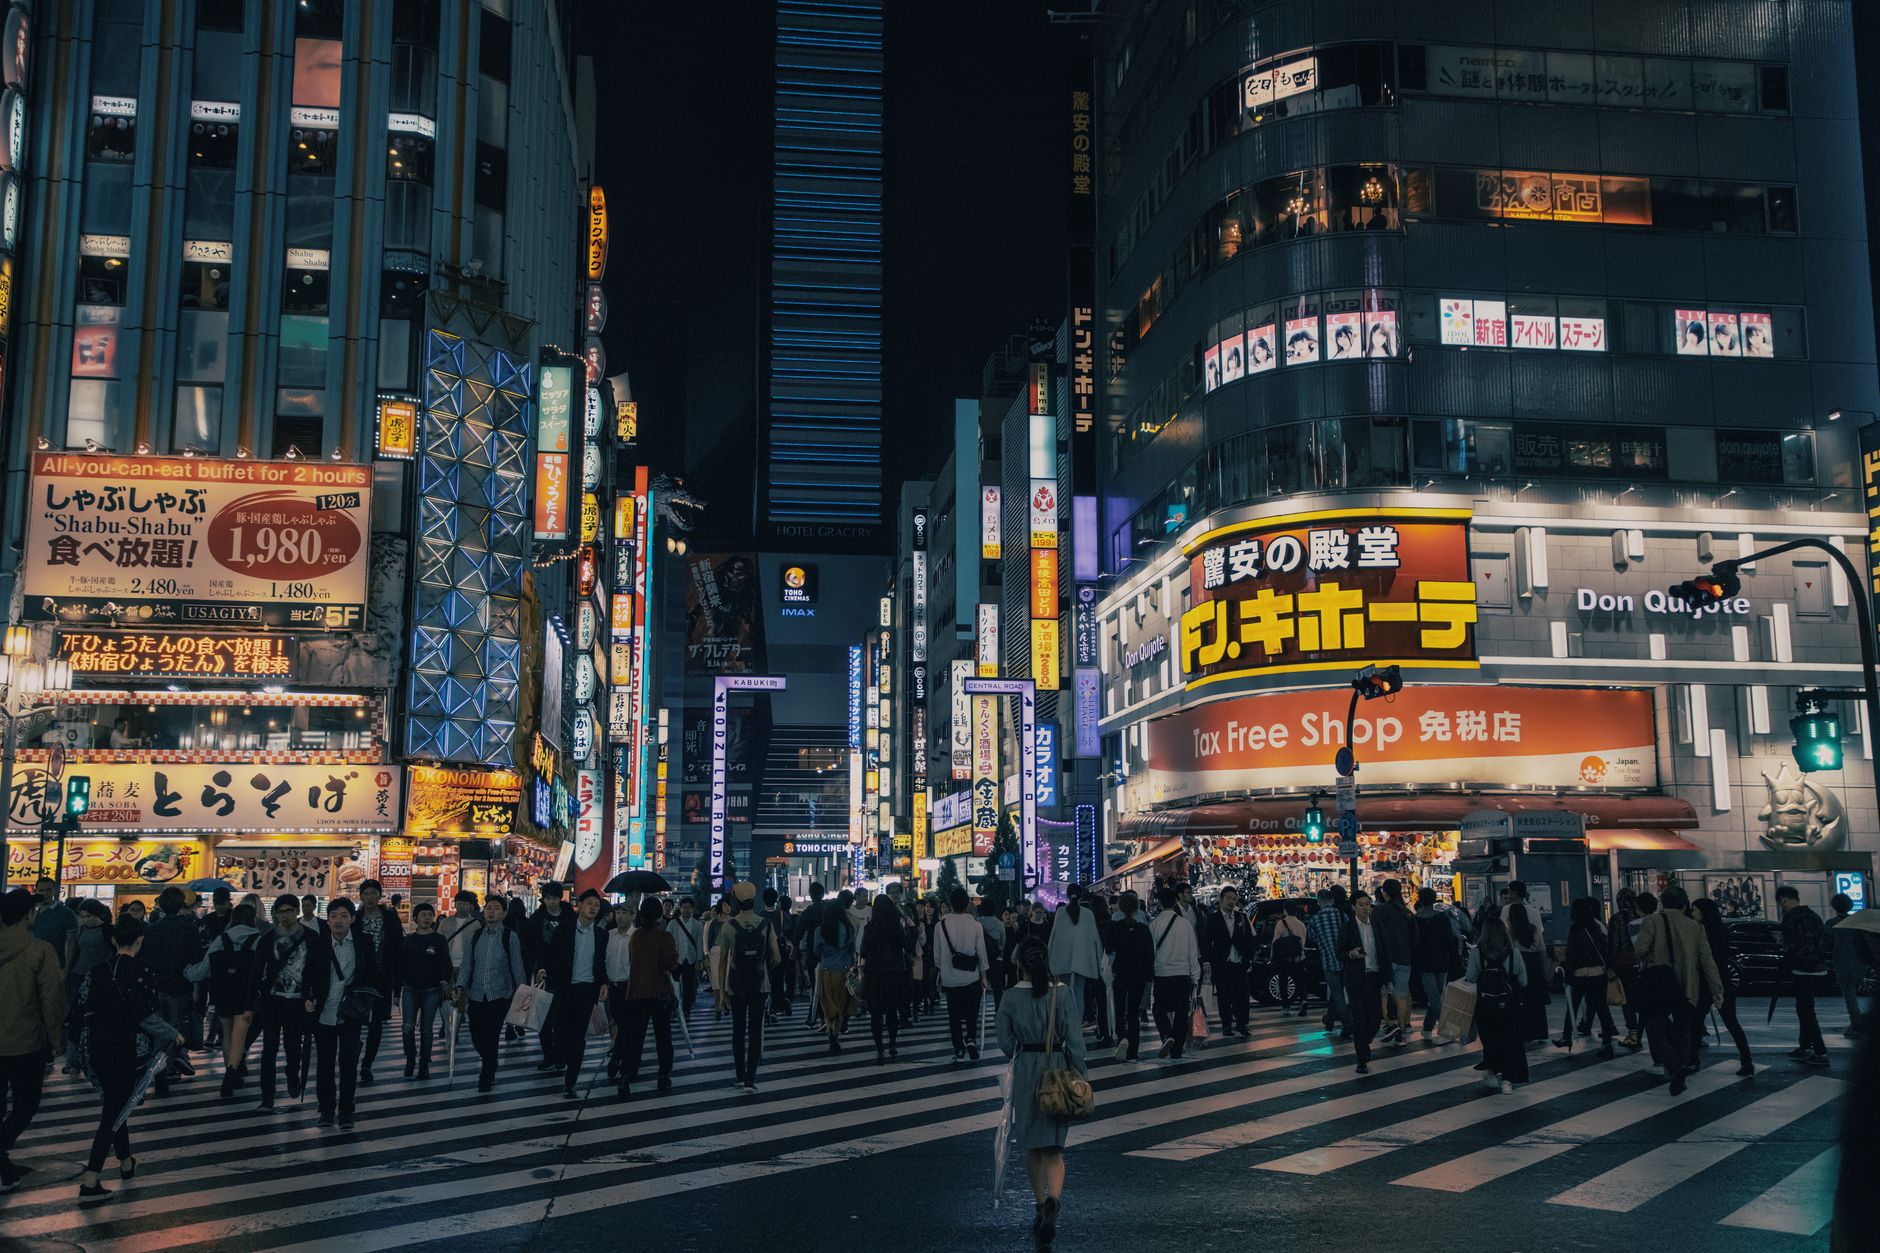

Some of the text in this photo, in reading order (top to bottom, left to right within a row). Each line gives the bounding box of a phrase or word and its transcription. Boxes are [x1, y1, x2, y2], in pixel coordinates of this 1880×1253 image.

[1458, 55, 1517, 68] namco
[1071, 90, 1091, 195] 驚安の殿堂
[289, 249, 314, 258] Shabu
[303, 258, 328, 267] Shabu
[1475, 317, 1604, 349] 新宿 アイドル ステージ
[540, 419, 568, 430] スイーツ
[42, 457, 366, 484] All-you-can-eat buffet for 2 hours
[46, 484, 208, 515] しゃぶしゃぶ
[319, 494, 357, 510] 120分
[543, 463, 563, 531] ひょうたん
[583, 506, 597, 532] 虎の子
[986, 514, 997, 542] 鳥メロ
[1032, 516, 1056, 525] 鳥メロ
[776, 525, 873, 538] HOTEL GRACERY
[227, 526, 347, 568] 1,980 yen
[1203, 526, 1401, 590] 驚安の殿堂
[130, 577, 195, 597] 2,480 yen
[269, 581, 331, 600] 1,480 yen
[784, 589, 804, 597] TOHO
[784, 595, 811, 603] CINEMAS
[1577, 588, 1635, 612] Don
[324, 606, 361, 627] 5F
[782, 608, 815, 618] IMAX
[1038, 631, 1052, 653] 酒場
[1125, 635, 1165, 669] Don Quijote
[913, 666, 926, 700] Booth
[968, 682, 1025, 690] CENTRAL ROAD
[980, 698, 992, 761] きんくら酒場
[1193, 709, 1522, 759] Tax Free Shop 免税店
[1035, 727, 1055, 804] カラオケ
[414, 768, 523, 789] OKONOMI YAKI
[712, 705, 726, 859] GODZILLA ROAD
[915, 777, 926, 785] 4F
[1023, 723, 1034, 849] ゴジラロード
[153, 769, 360, 819] とらそば
[579, 774, 594, 833] トラノコ
[974, 777, 998, 829] 金の蔵
[108, 801, 138, 809] SOBA
[1248, 817, 1280, 831] Don
[795, 843, 821, 854] TOHO
[974, 833, 992, 847] 2F
[251, 869, 331, 890] とらそば
[1838, 877, 1852, 895] P
